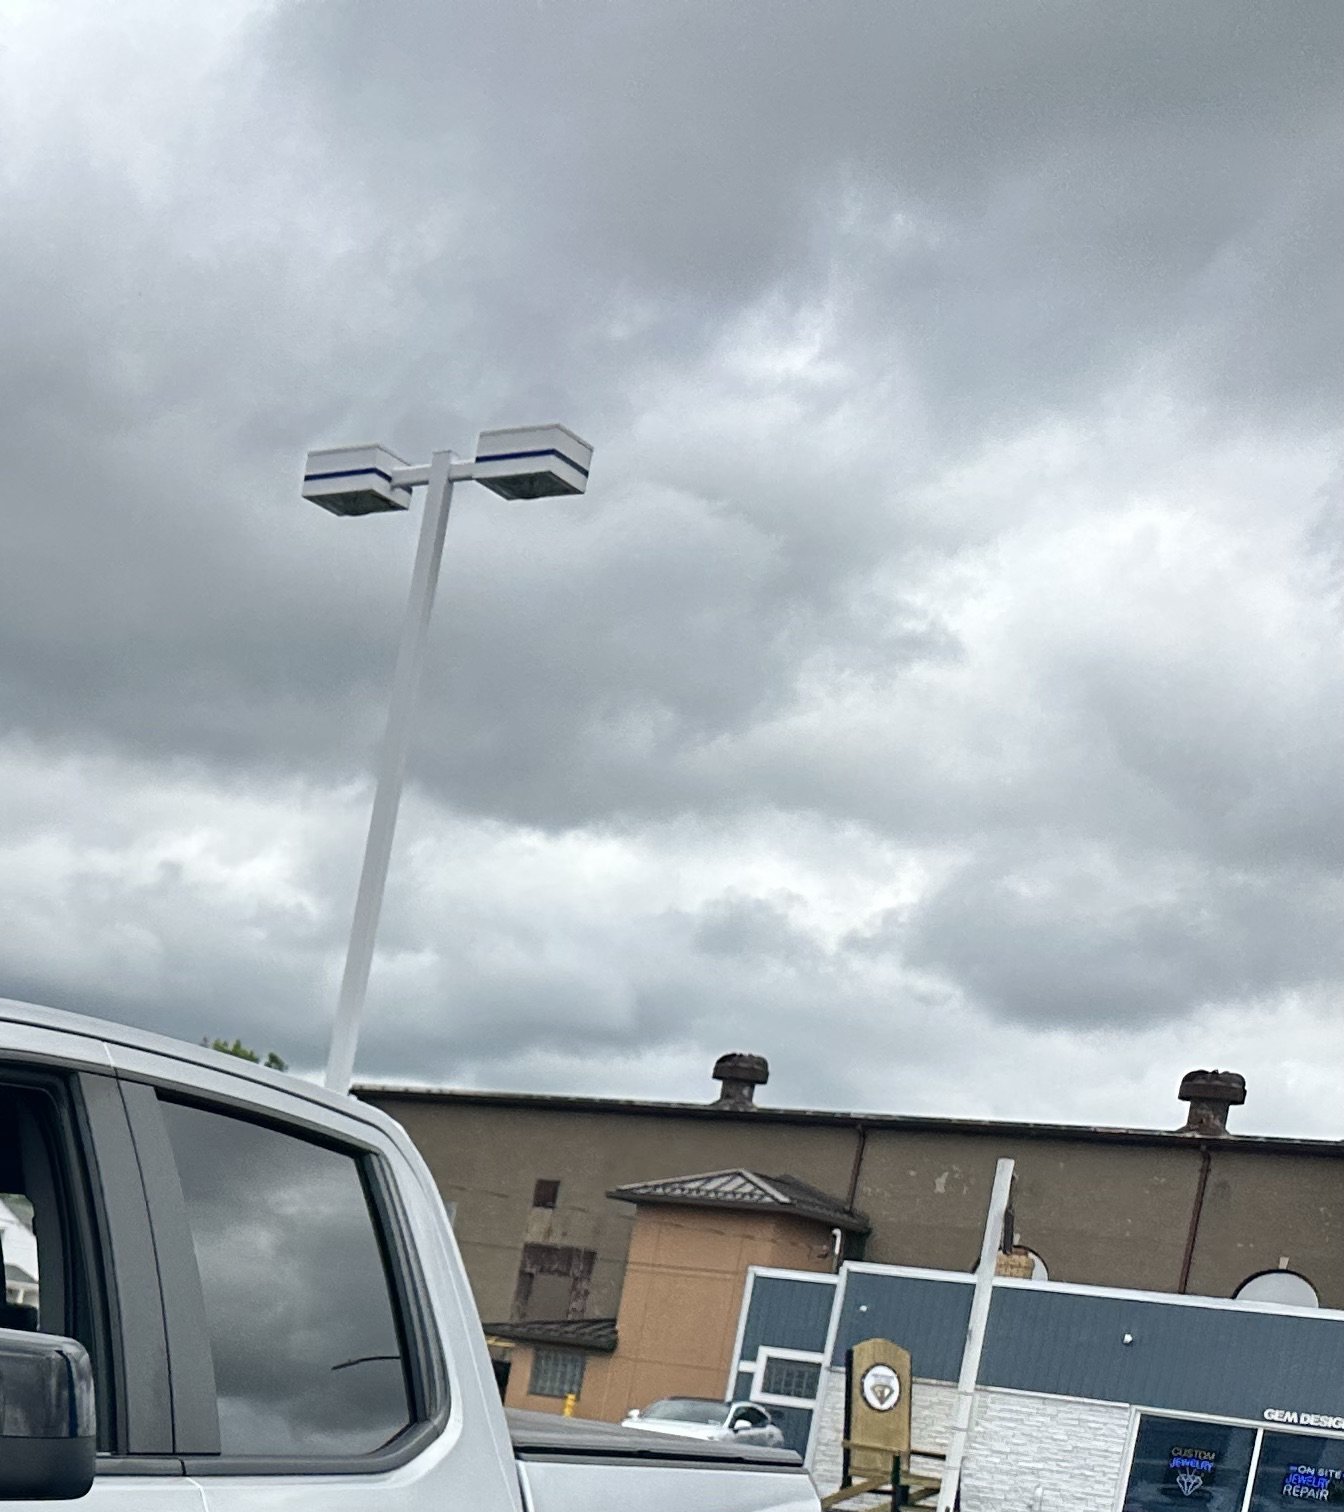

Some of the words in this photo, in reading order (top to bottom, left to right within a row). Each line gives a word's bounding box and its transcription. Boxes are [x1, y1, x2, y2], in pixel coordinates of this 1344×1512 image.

[1263, 1408, 1298, 1424] GEM
[1299, 1412, 1344, 1429] DESIG
[1171, 1447, 1216, 1460] CUSTOM
[1169, 1457, 1215, 1472] JEWELRY
[1297, 1465, 1315, 1475] ON
[1317, 1468, 1342, 1480] SITE
[1285, 1473, 1330, 1489] JEWELRY
[1282, 1483, 1329, 1500] REPAIR
